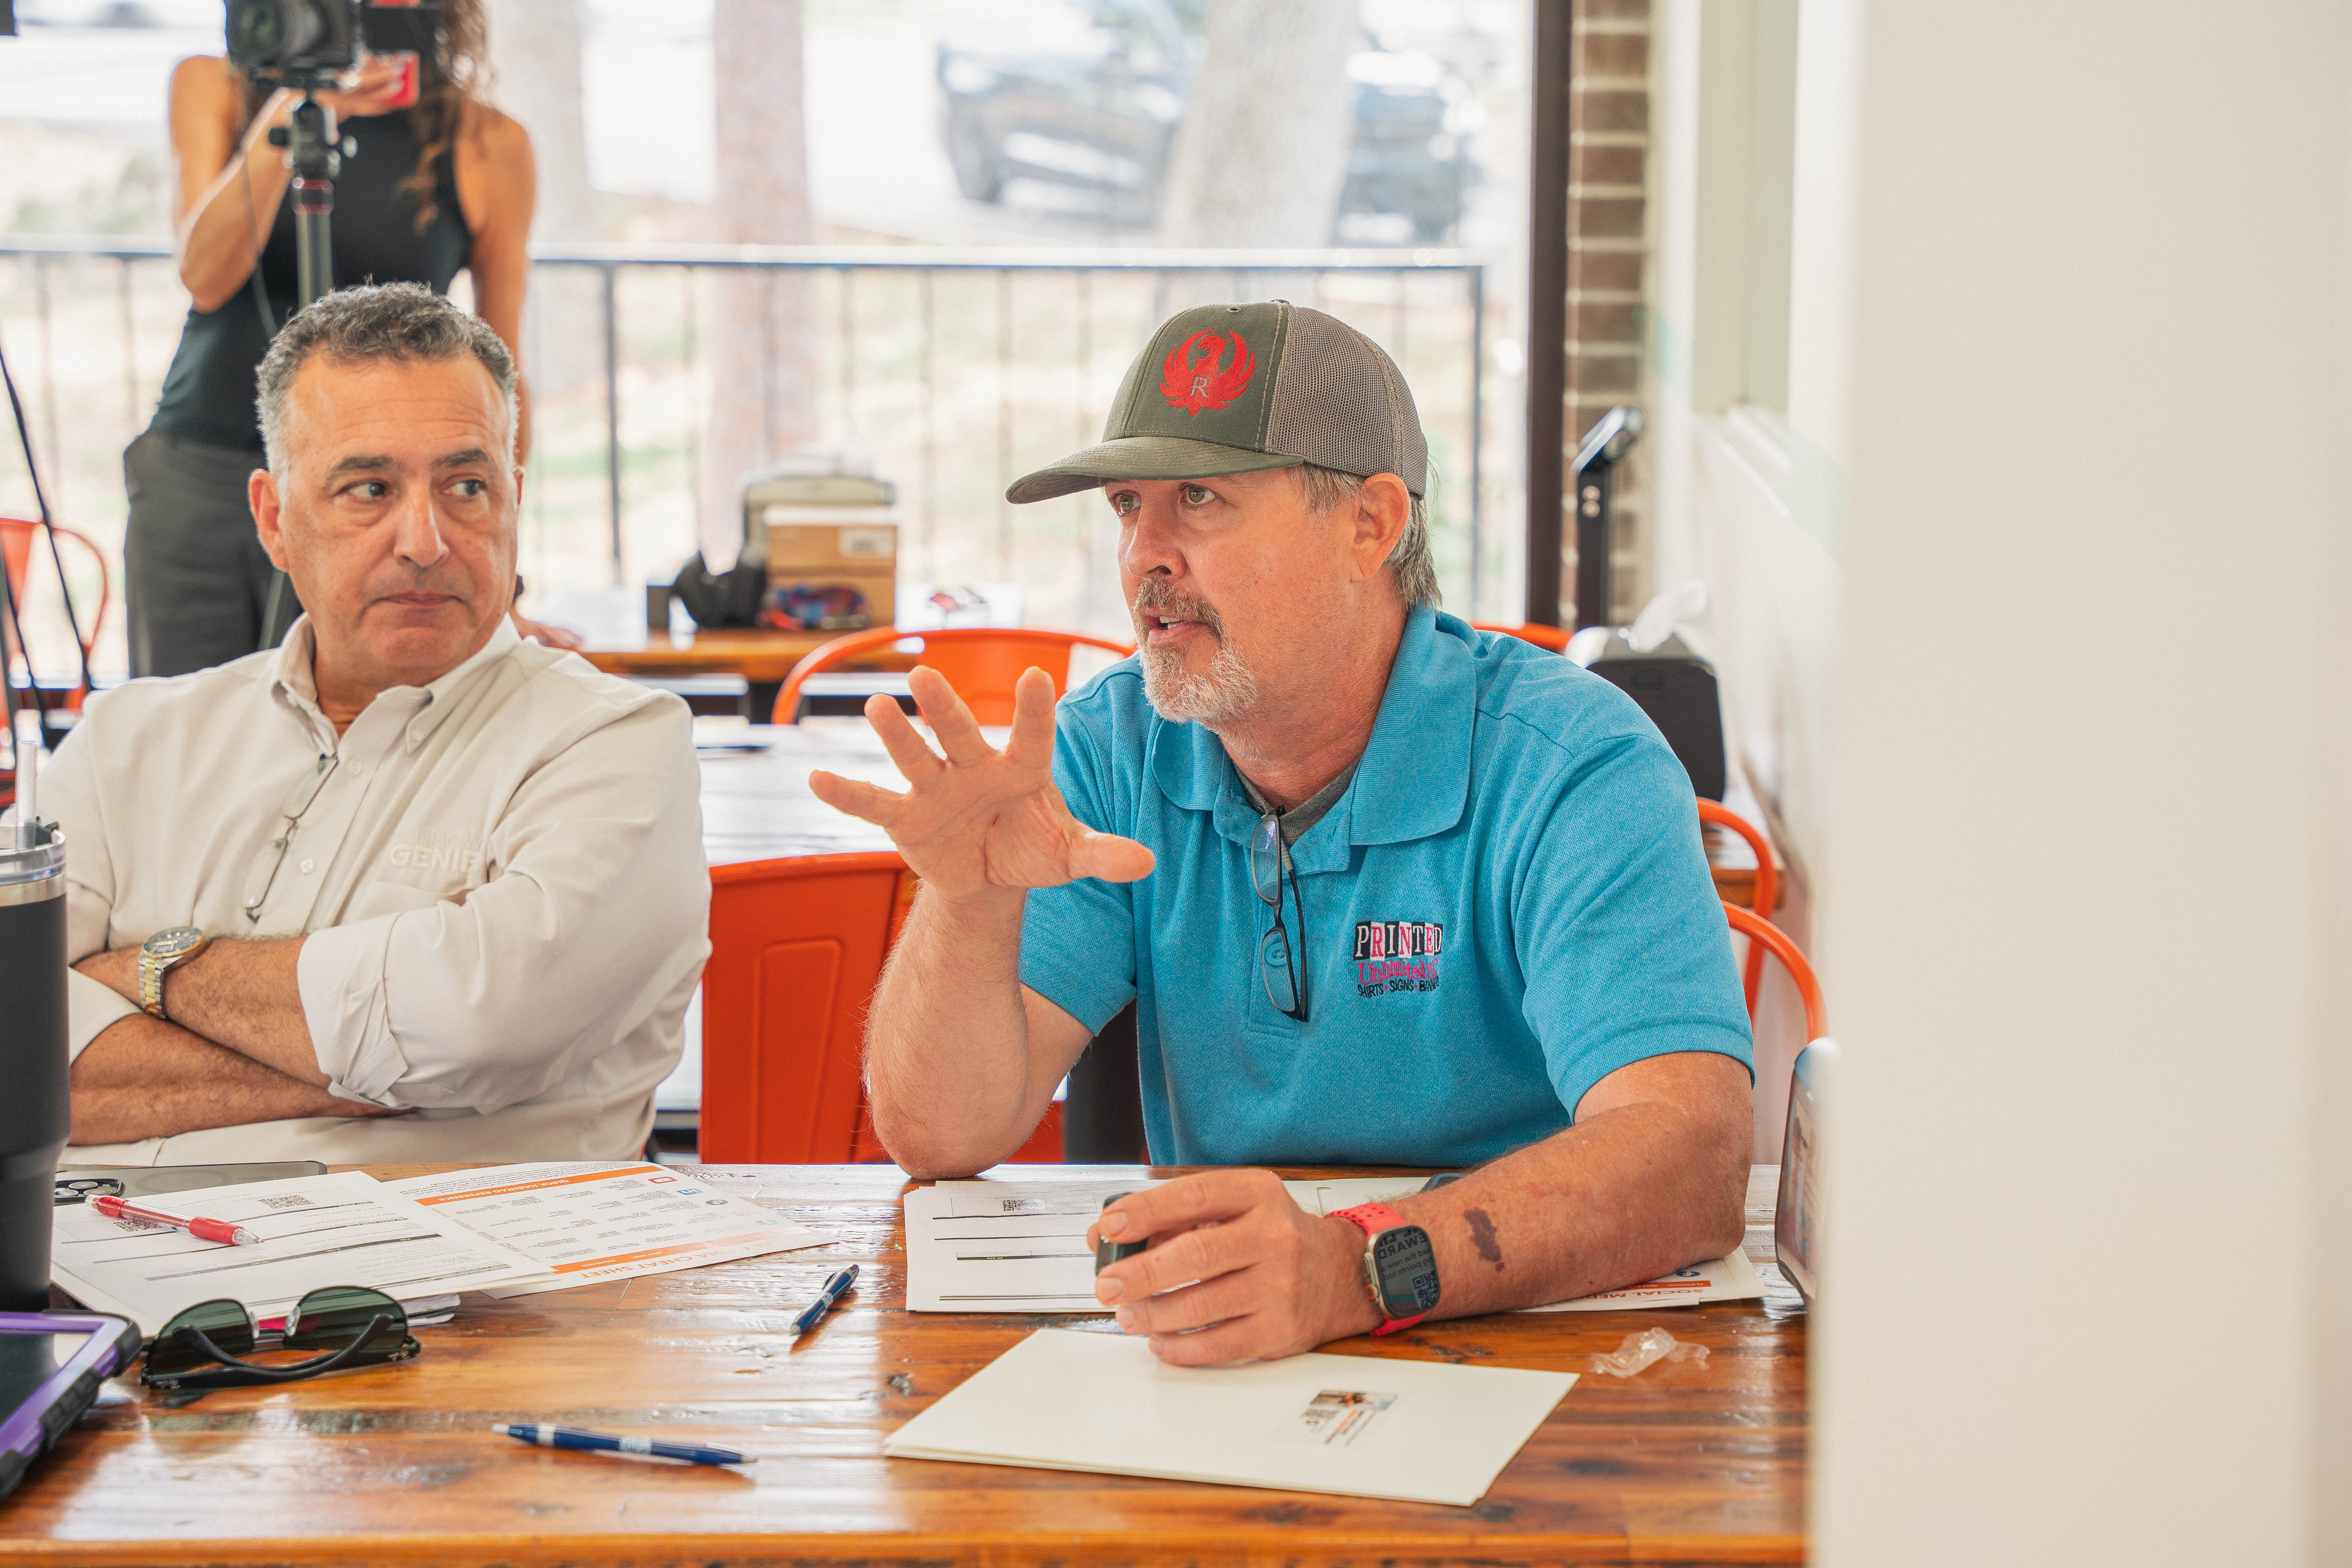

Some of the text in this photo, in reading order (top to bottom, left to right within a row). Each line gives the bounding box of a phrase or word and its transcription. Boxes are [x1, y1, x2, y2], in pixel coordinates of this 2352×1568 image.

[1190, 377, 1209, 397] R
[1355, 925, 1442, 957] PRINTED
[1357, 958, 1426, 985] Unlimited
[1357, 983, 1384, 998] SHIRTS
[1389, 979, 1414, 992] SIGNS
[437, 1191, 492, 1201] REFERENCE
[492, 1184, 538, 1193] HASHTAG
[636, 1256, 693, 1269] CHEAT
[580, 1266, 634, 1279] SHEET
